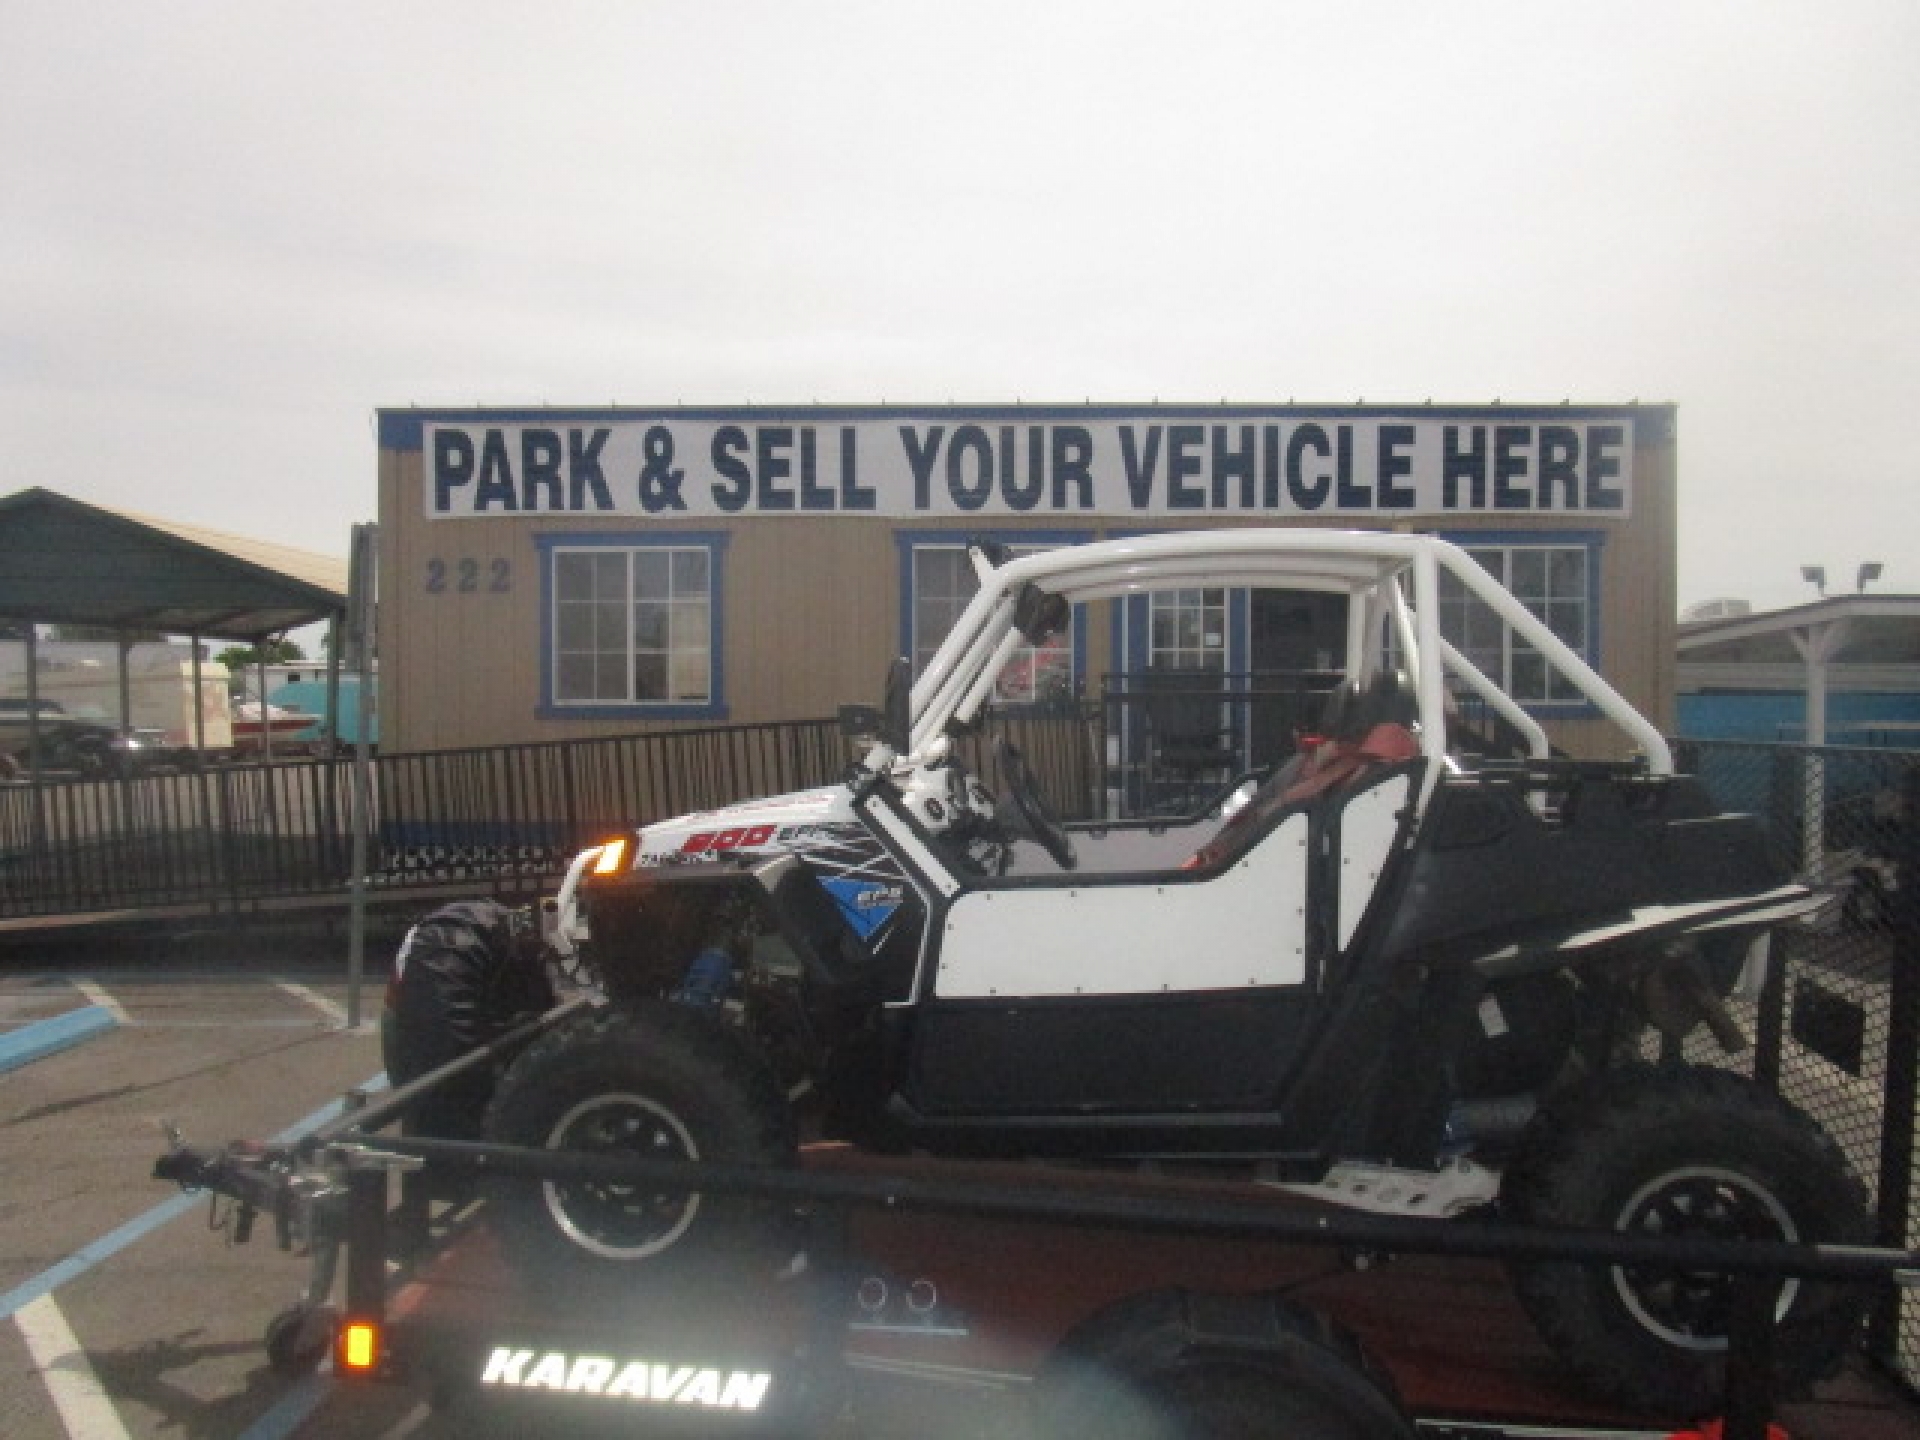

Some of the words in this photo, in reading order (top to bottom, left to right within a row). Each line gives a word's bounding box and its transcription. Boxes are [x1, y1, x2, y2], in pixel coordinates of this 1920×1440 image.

[433, 428, 614, 512] PARK
[638, 426, 688, 513] &
[710, 426, 877, 511] SELL
[899, 425, 1095, 512] YOUR
[1118, 423, 1416, 511] VEHICLE
[1441, 424, 1624, 510] HERE
[425, 558, 512, 594] 222
[481, 1346, 771, 1411] KARAVAN
